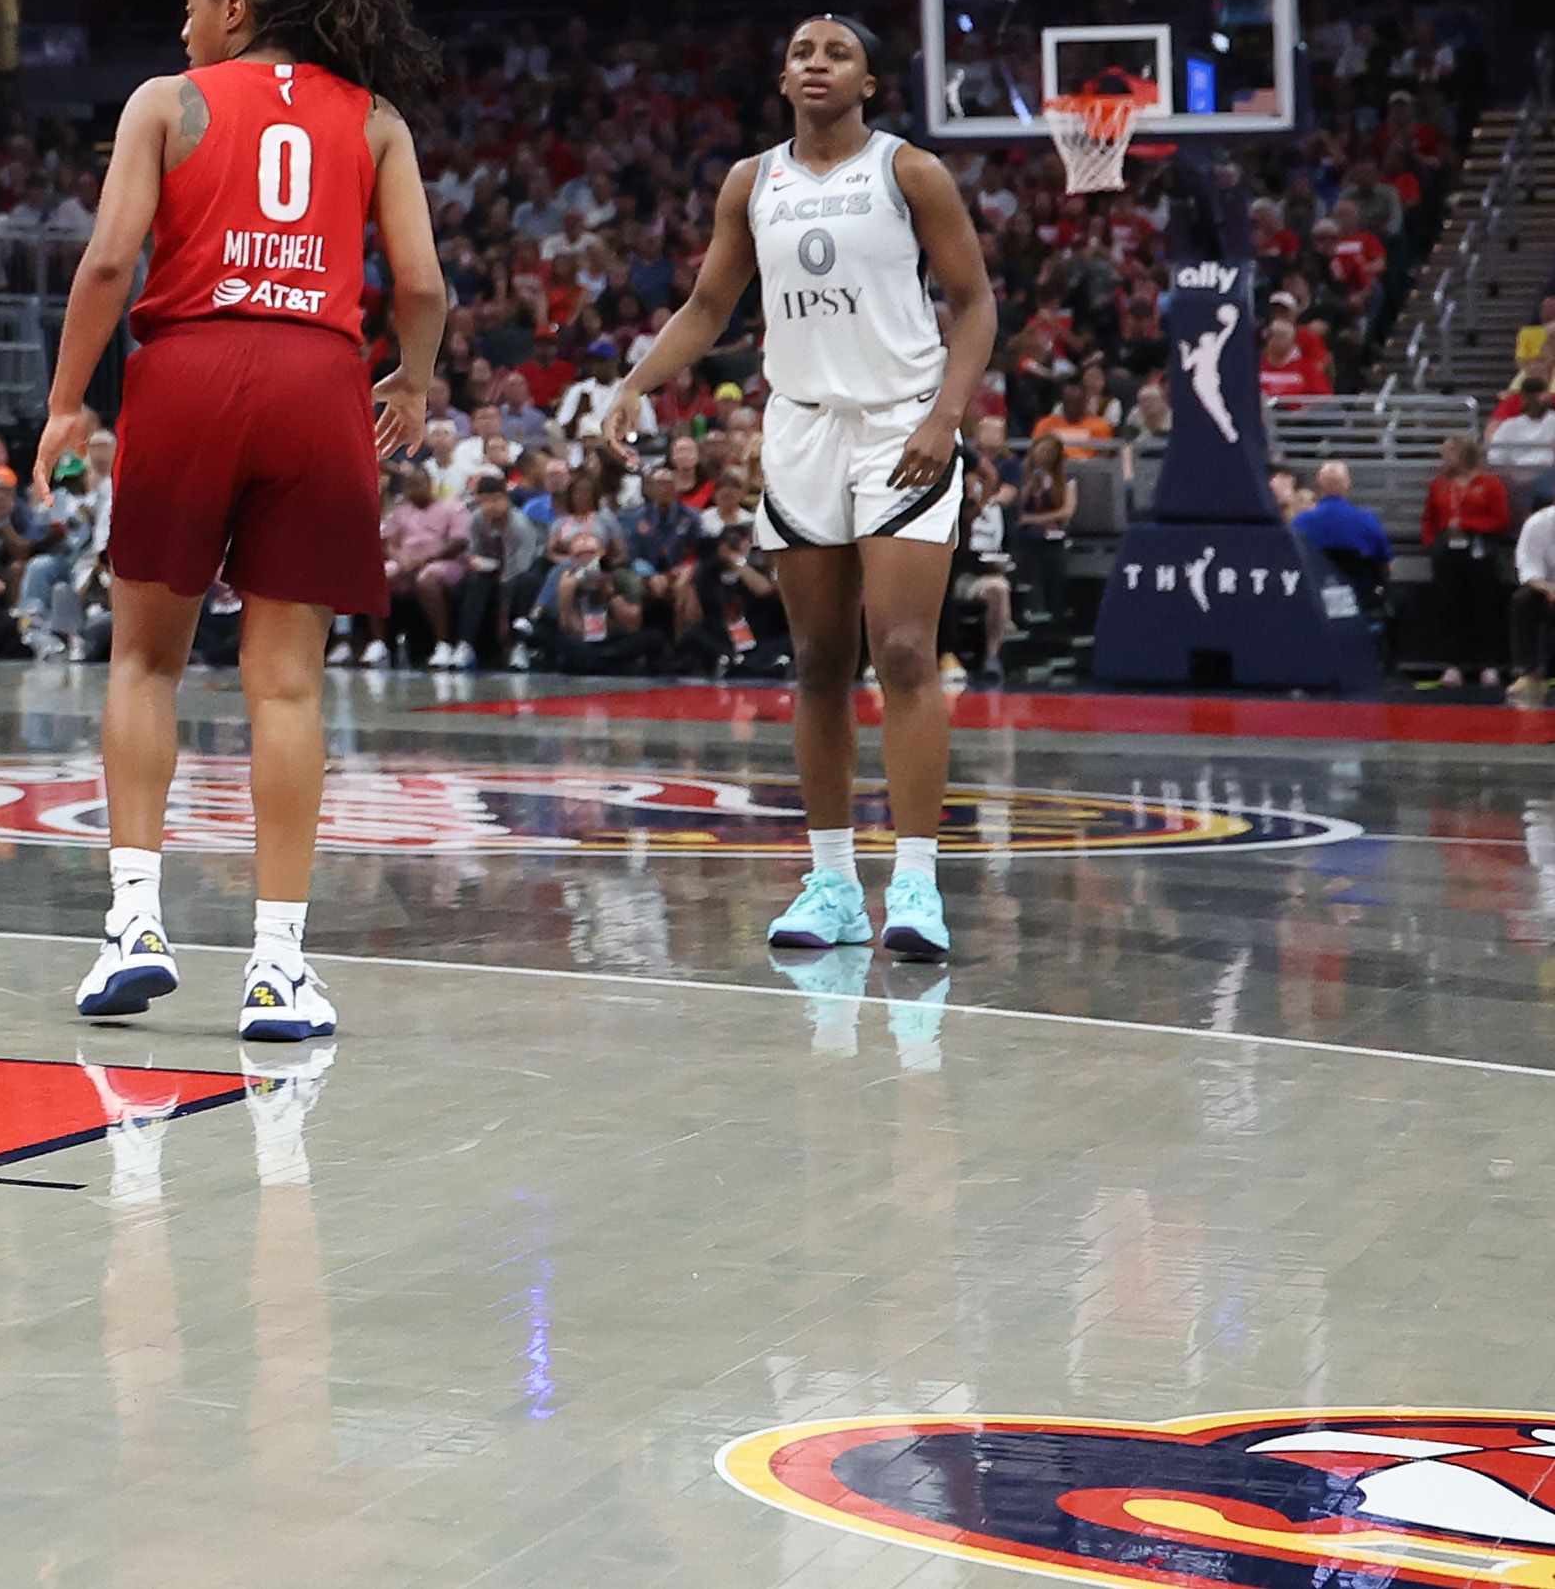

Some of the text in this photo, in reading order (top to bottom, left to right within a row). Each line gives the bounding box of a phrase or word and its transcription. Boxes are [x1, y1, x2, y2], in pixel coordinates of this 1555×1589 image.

[257, 122, 313, 224] 0
[769, 191, 873, 226] ACES
[222, 229, 327, 273] MITCHELL
[798, 227, 836, 276] 0
[1177, 261, 1239, 294] ally
[250, 279, 327, 314] AT&T
[782, 286, 864, 320] IPSY
